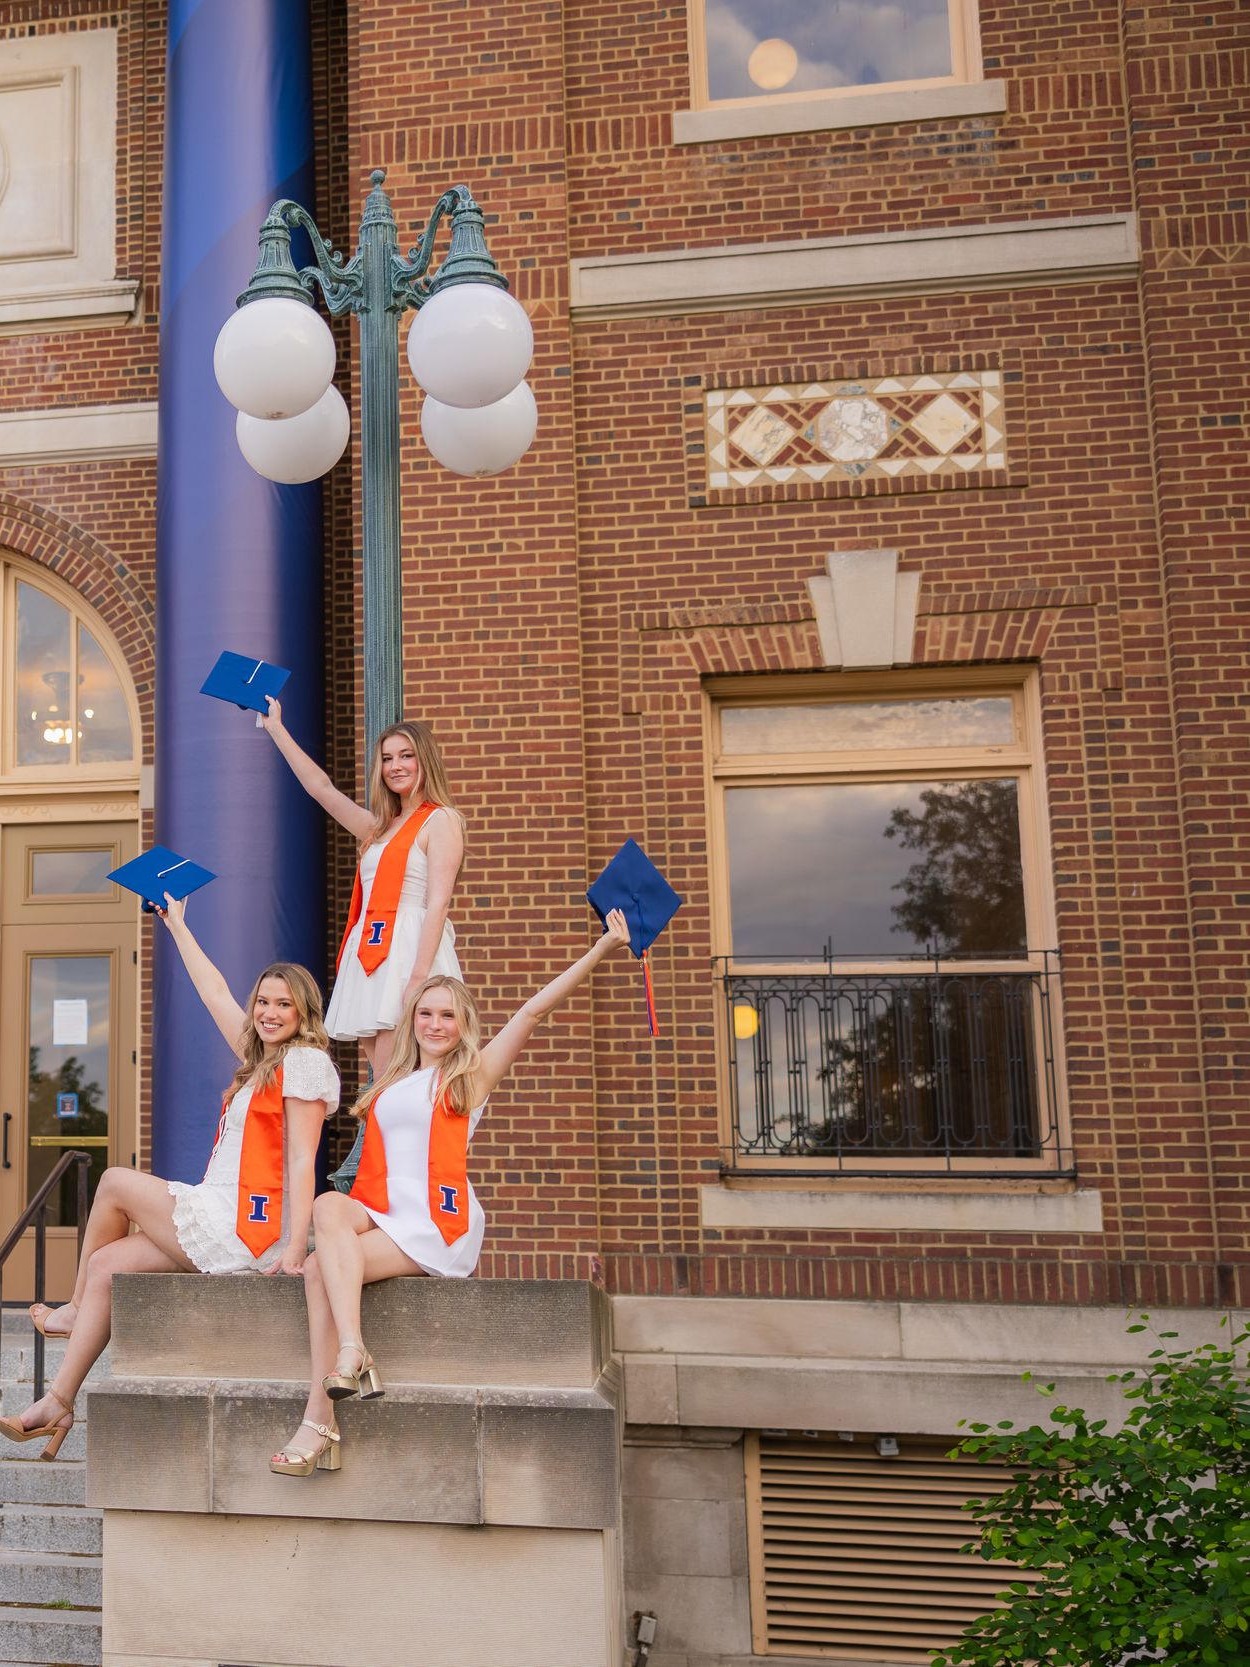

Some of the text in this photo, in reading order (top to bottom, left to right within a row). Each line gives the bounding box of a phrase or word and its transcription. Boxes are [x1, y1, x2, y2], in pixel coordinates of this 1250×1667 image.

[367, 921, 386, 945] I
[248, 1194, 270, 1222] I
[439, 1184, 459, 1215] I
